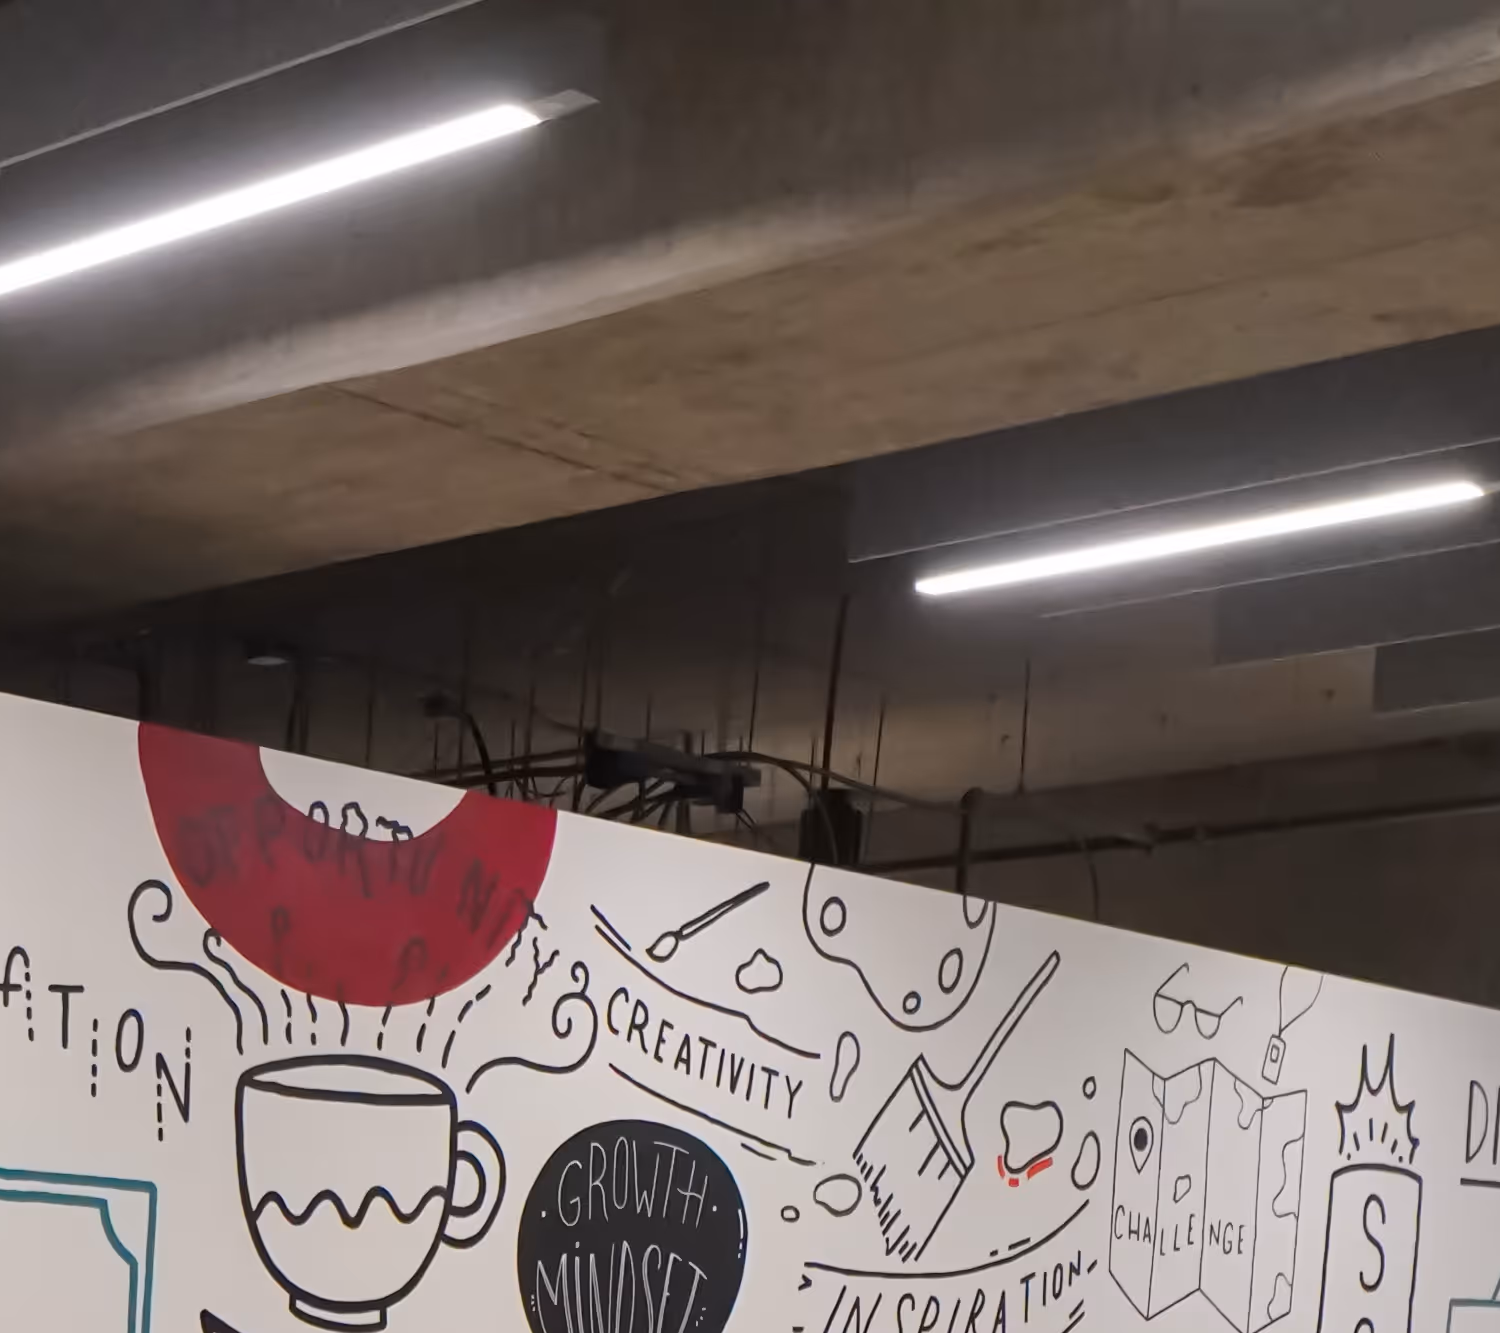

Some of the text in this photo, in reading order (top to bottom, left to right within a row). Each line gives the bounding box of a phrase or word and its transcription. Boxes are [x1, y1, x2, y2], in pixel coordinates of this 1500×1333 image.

[606, 986, 803, 1119] CREATIVITY
[557, 1136, 709, 1228] GROWTH
[1113, 1204, 1246, 1257] CHALLENGE
